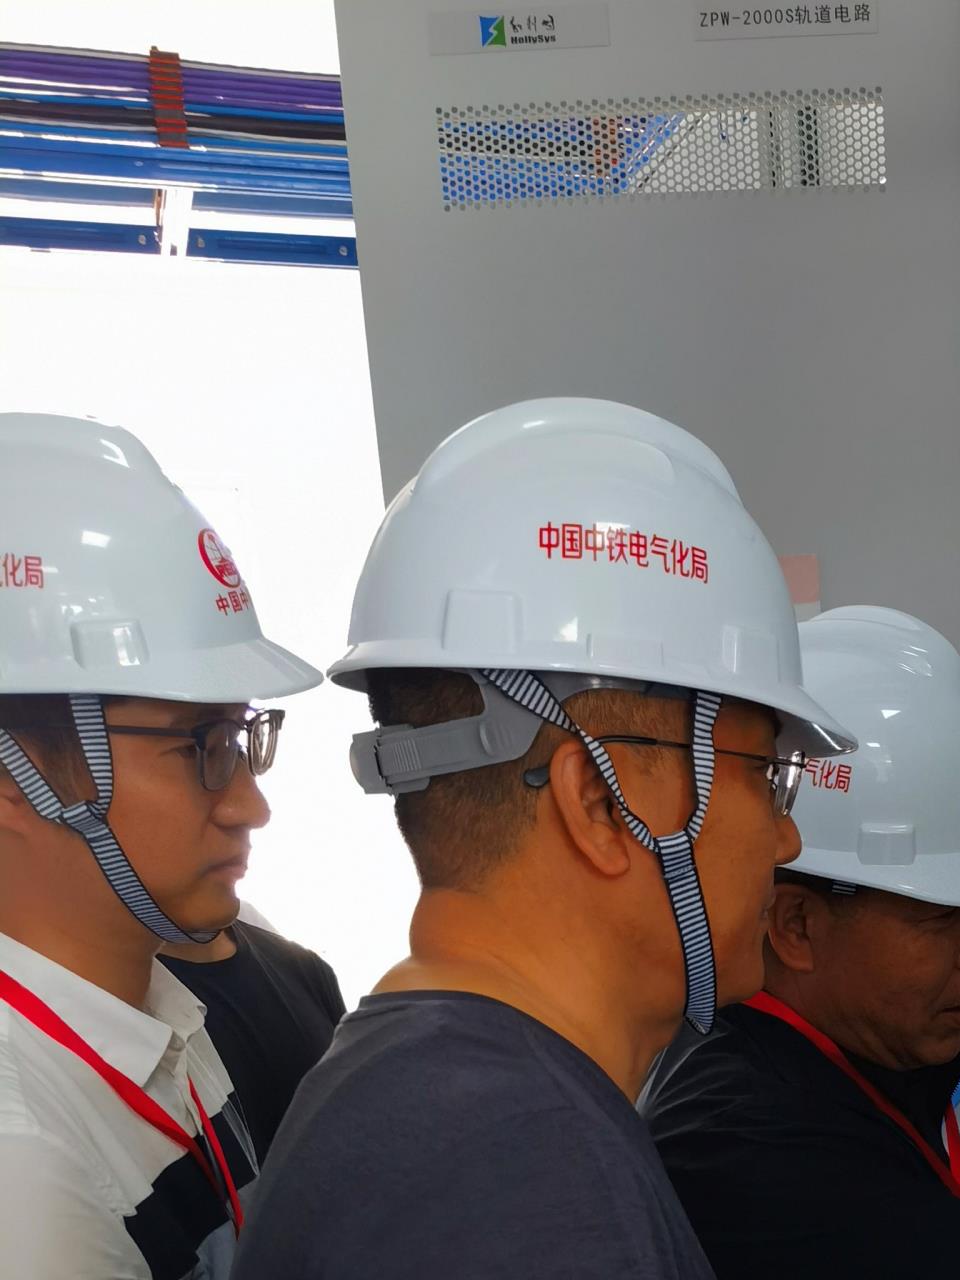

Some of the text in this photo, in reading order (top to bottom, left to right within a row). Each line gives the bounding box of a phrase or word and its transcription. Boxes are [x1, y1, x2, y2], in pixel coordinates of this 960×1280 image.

[699, 3, 871, 28] ZPW-2000S轨道电路
[0, 552, 43, 588] 化局
[539, 521, 708, 584] 中国中铁电气化局
